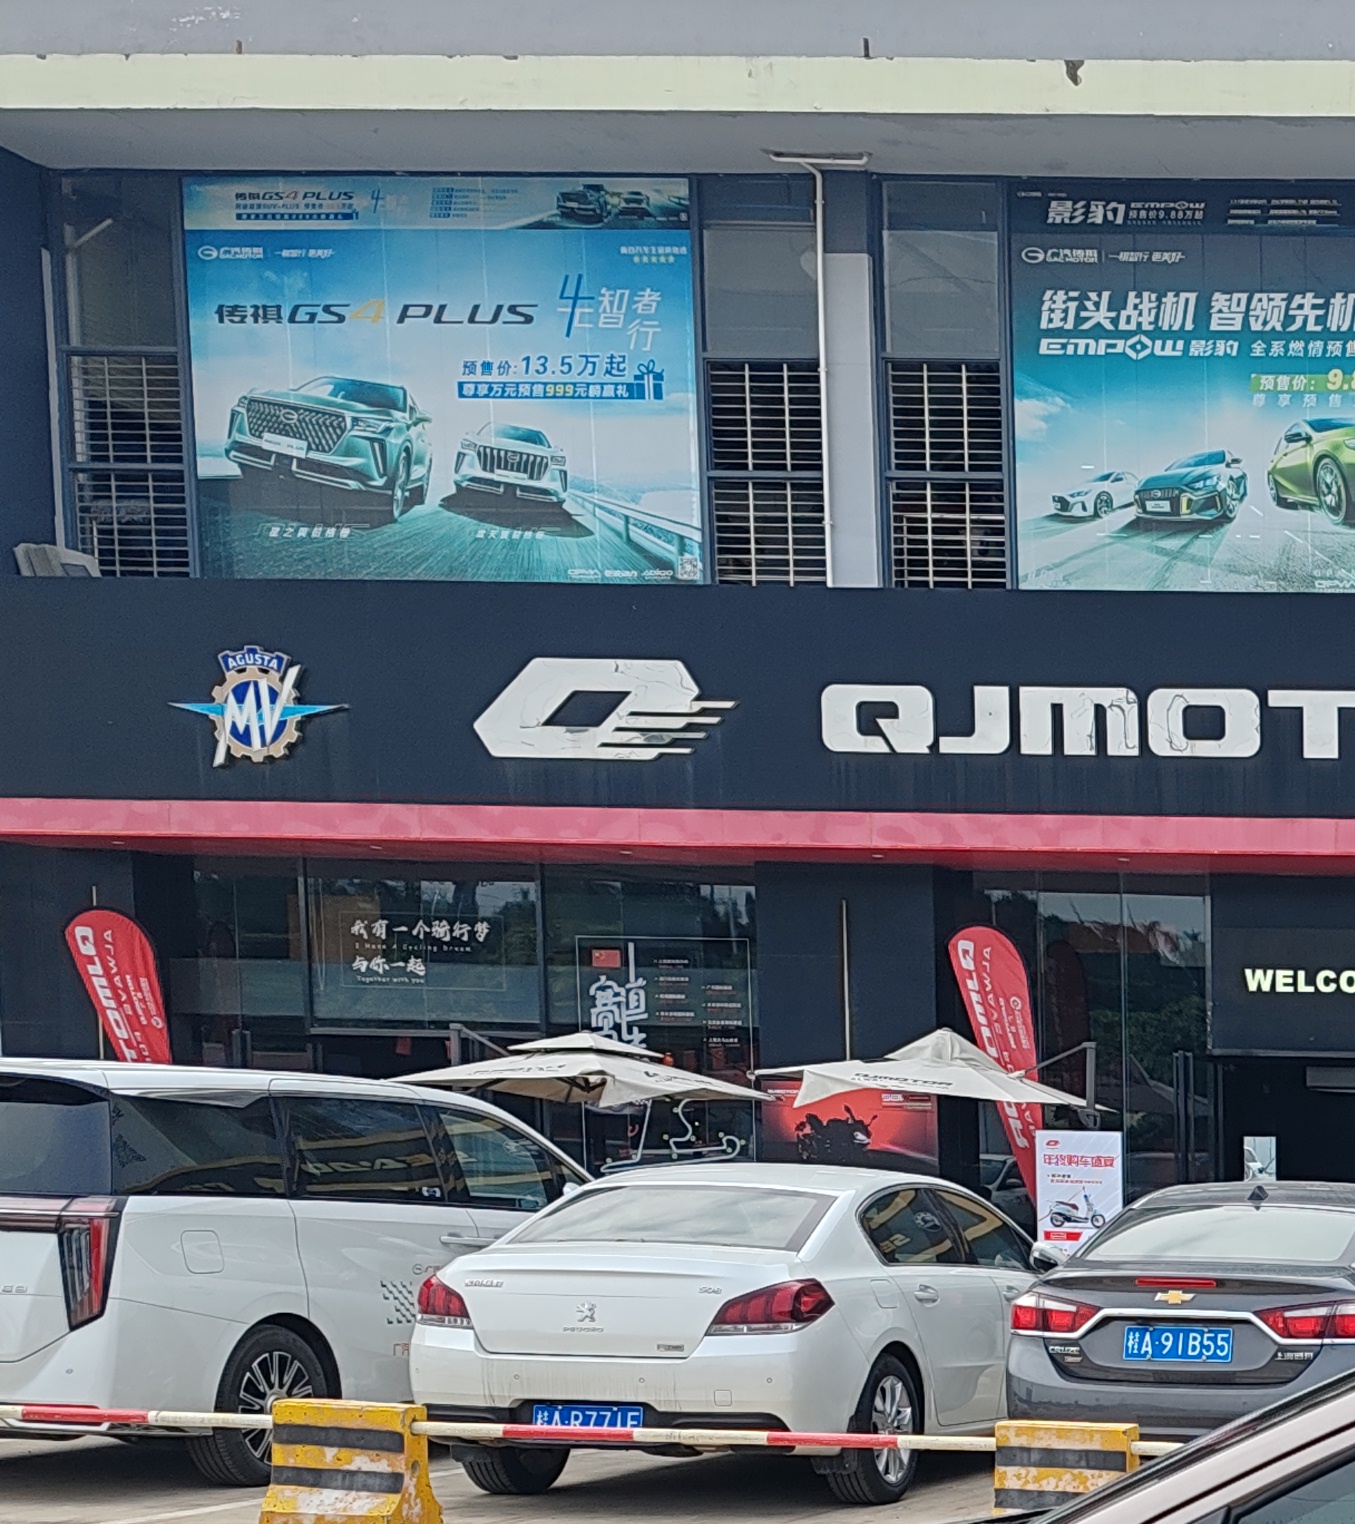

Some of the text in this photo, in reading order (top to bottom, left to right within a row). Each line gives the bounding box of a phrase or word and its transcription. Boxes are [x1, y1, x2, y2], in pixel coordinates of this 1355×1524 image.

[302, 191, 355, 200] PLUS
[1046, 200, 1126, 225] 影豹
[215, 299, 539, 325] 传祺GS4 PLUS
[1039, 289, 1198, 331] 街头战机
[1039, 334, 1184, 360] EMPOW
[1188, 339, 1239, 357] 影豹
[227, 653, 279, 670] AGUSTA
[213, 664, 301, 768] MV
[350, 918, 491, 943] 我有一个骑行梦
[351, 954, 427, 976] 与你一起
[1049, 1345, 1081, 1355] CRUZE
